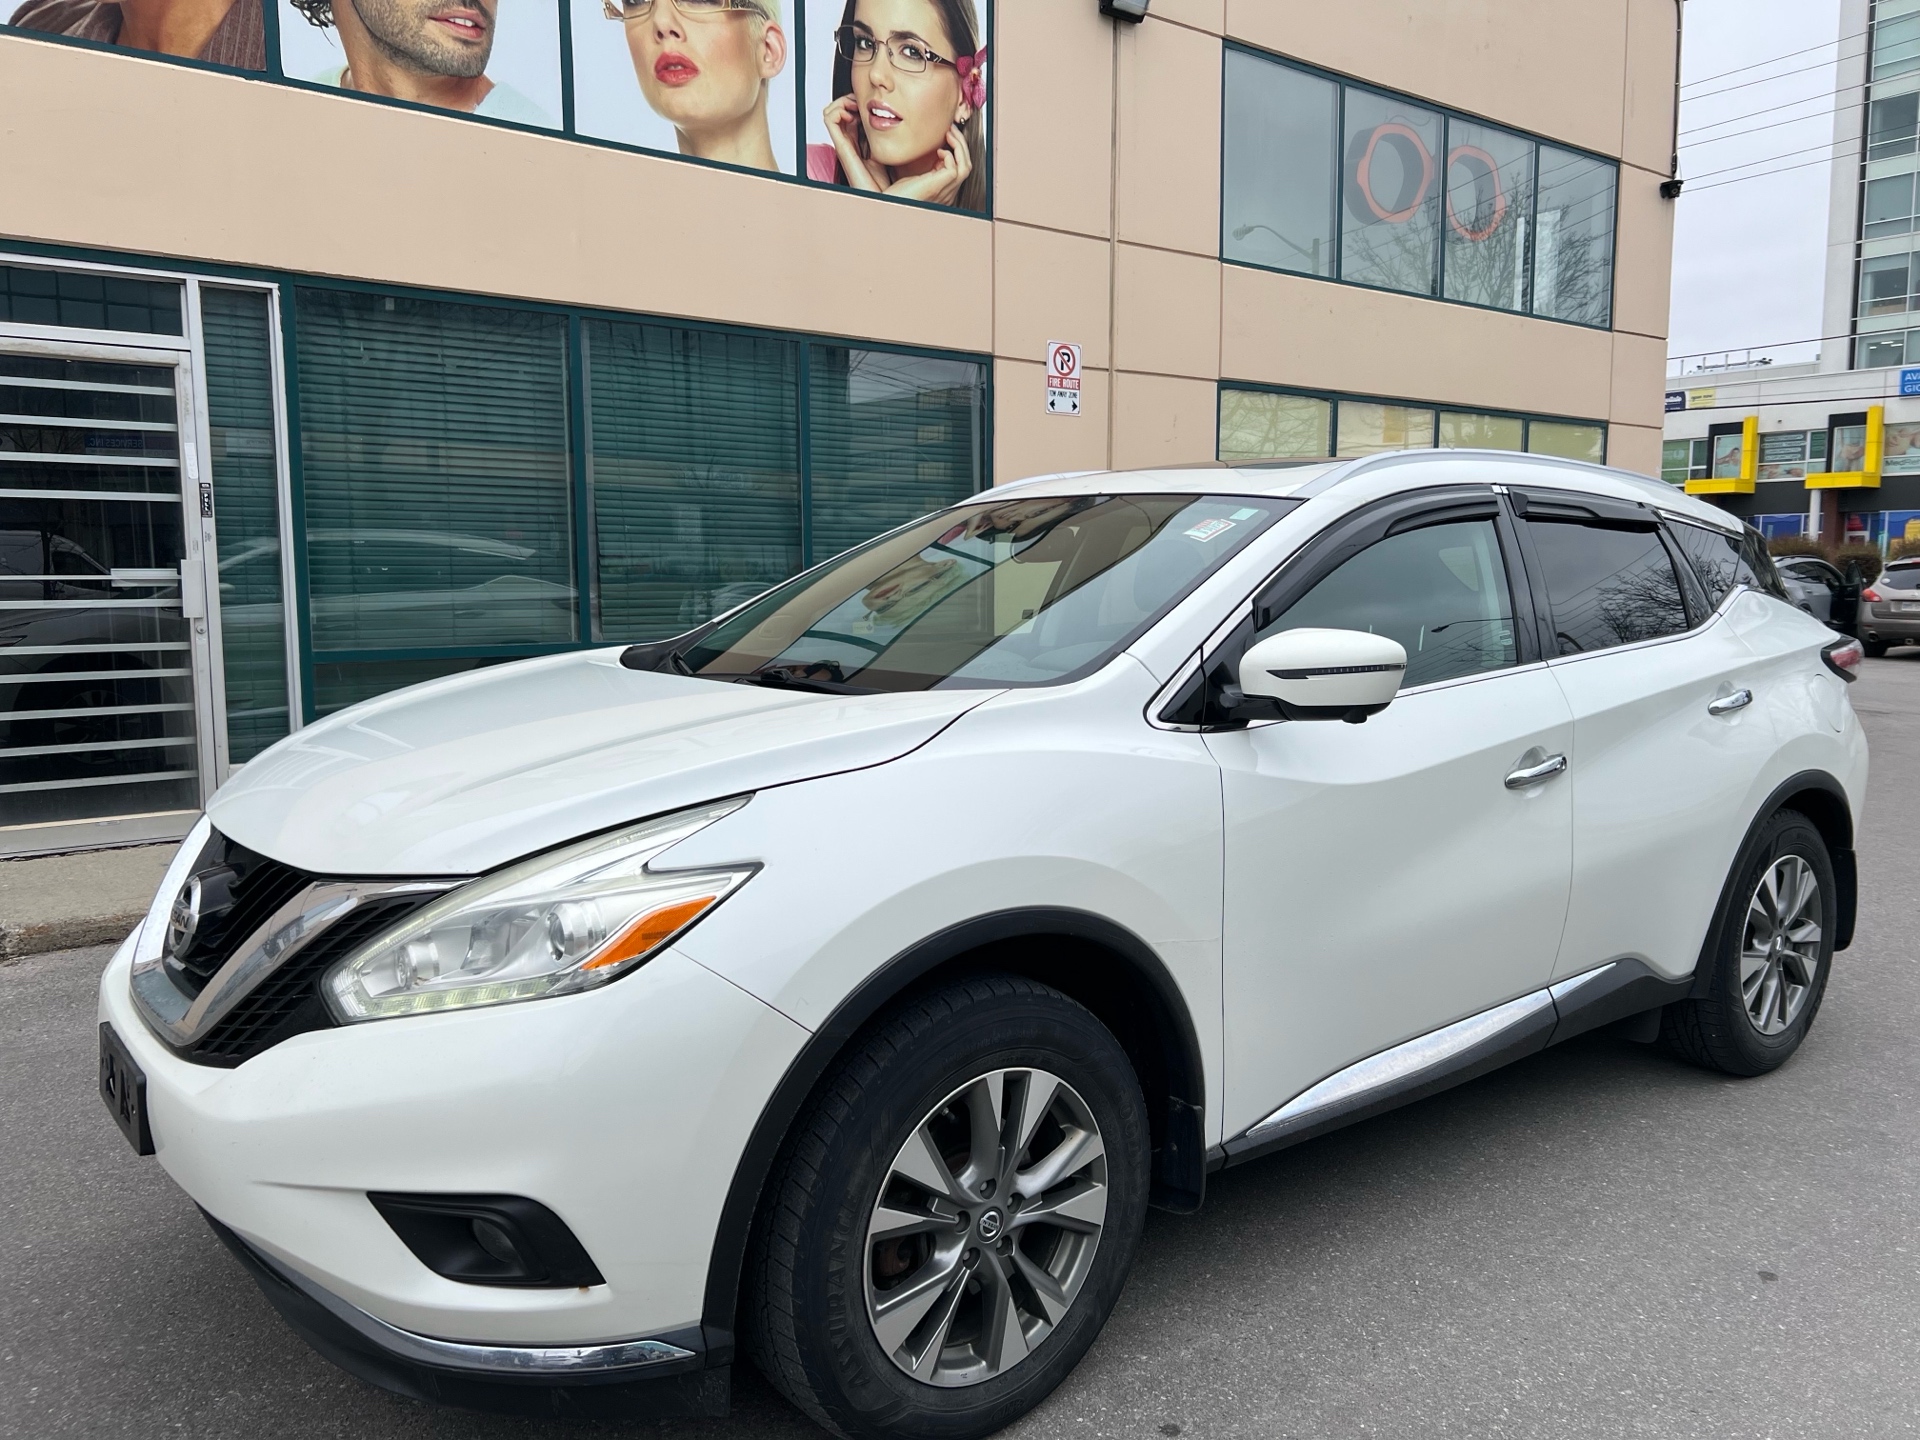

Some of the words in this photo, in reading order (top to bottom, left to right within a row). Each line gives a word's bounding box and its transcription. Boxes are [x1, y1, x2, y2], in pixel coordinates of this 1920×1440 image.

[1049, 377, 1061, 387] FIRE
[1062, 379, 1079, 389] ROUTE
[1057, 390, 1067, 398] AWAY
[1068, 391, 1078, 399] ZONE
